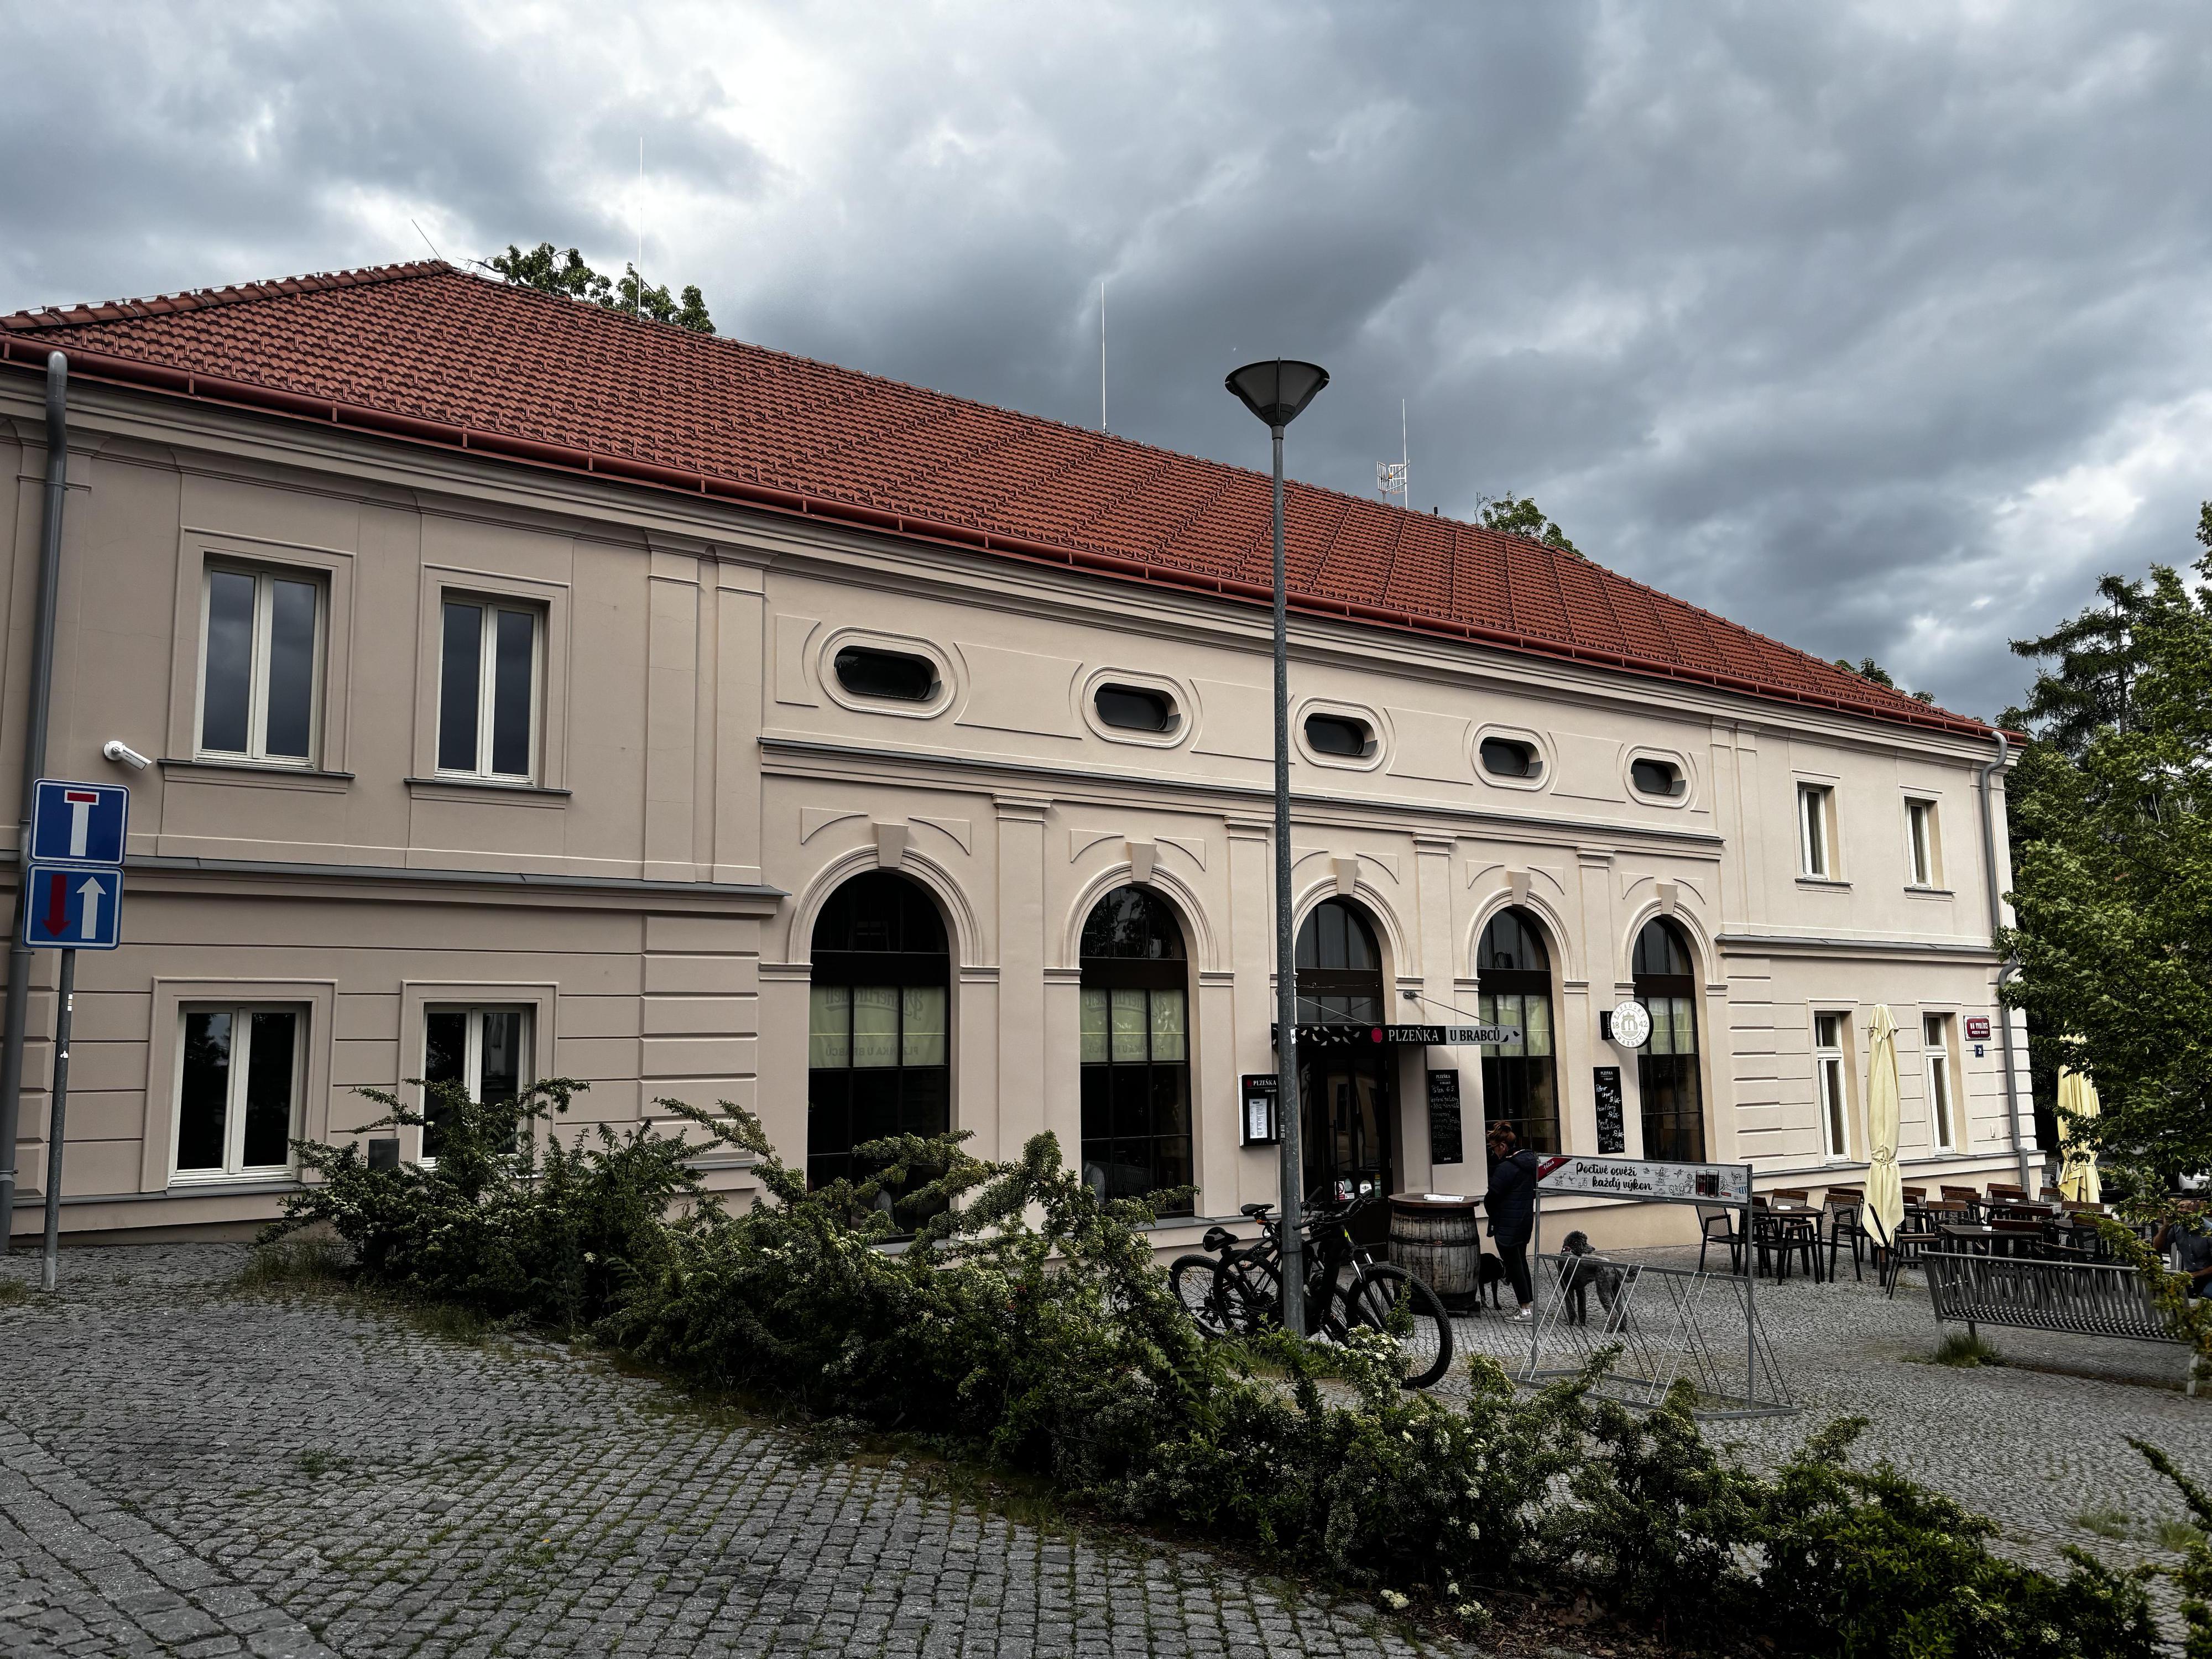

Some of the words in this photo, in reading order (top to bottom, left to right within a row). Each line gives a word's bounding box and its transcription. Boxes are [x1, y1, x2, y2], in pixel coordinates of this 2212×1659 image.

[1389, 1027, 1439, 1041] PLZEŇKA
[1450, 1030, 1457, 1041] U
[1459, 1027, 1500, 1041] BRABCŮ
[1576, 1162, 1609, 1175] Poctivé
[1610, 1166, 1637, 1177] osvěží
[1592, 1176, 1621, 1191] každý
[1623, 1176, 1652, 1191] výkon
